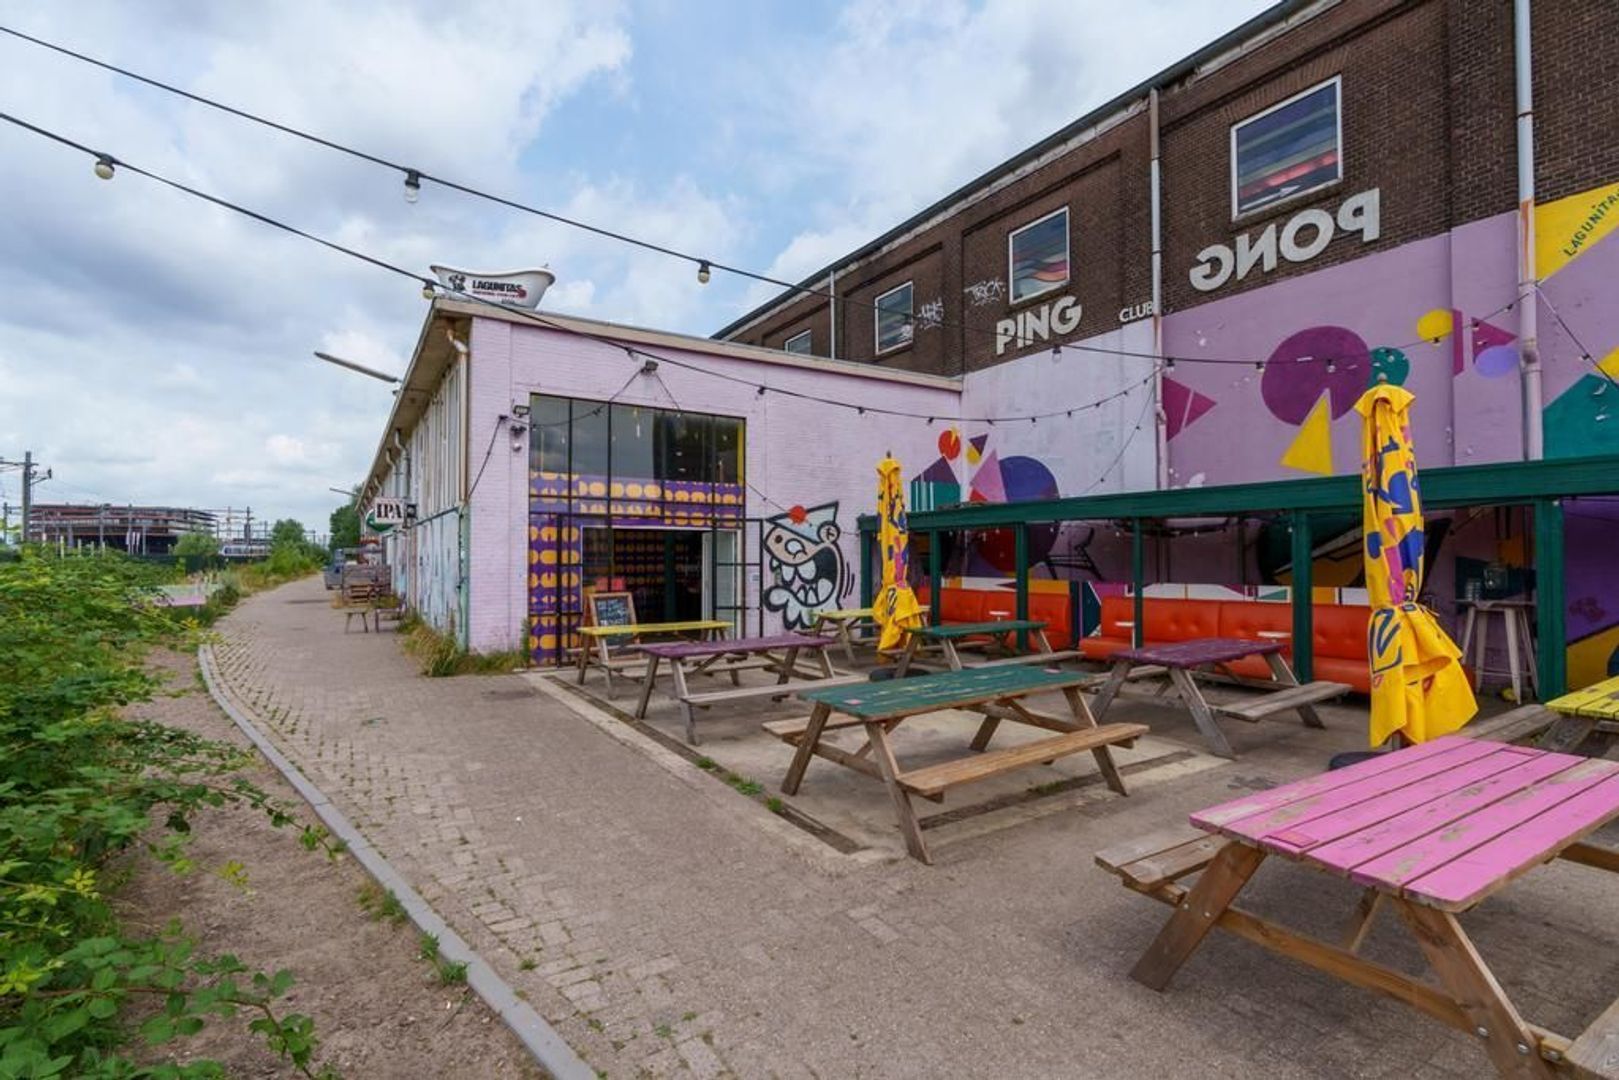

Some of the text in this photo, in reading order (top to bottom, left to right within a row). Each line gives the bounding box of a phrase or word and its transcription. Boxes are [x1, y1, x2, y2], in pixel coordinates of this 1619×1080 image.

[1563, 188, 1619, 256] LAGUNITA
[996, 296, 1153, 355] PING CLUB
[376, 502, 402, 519] IPA
